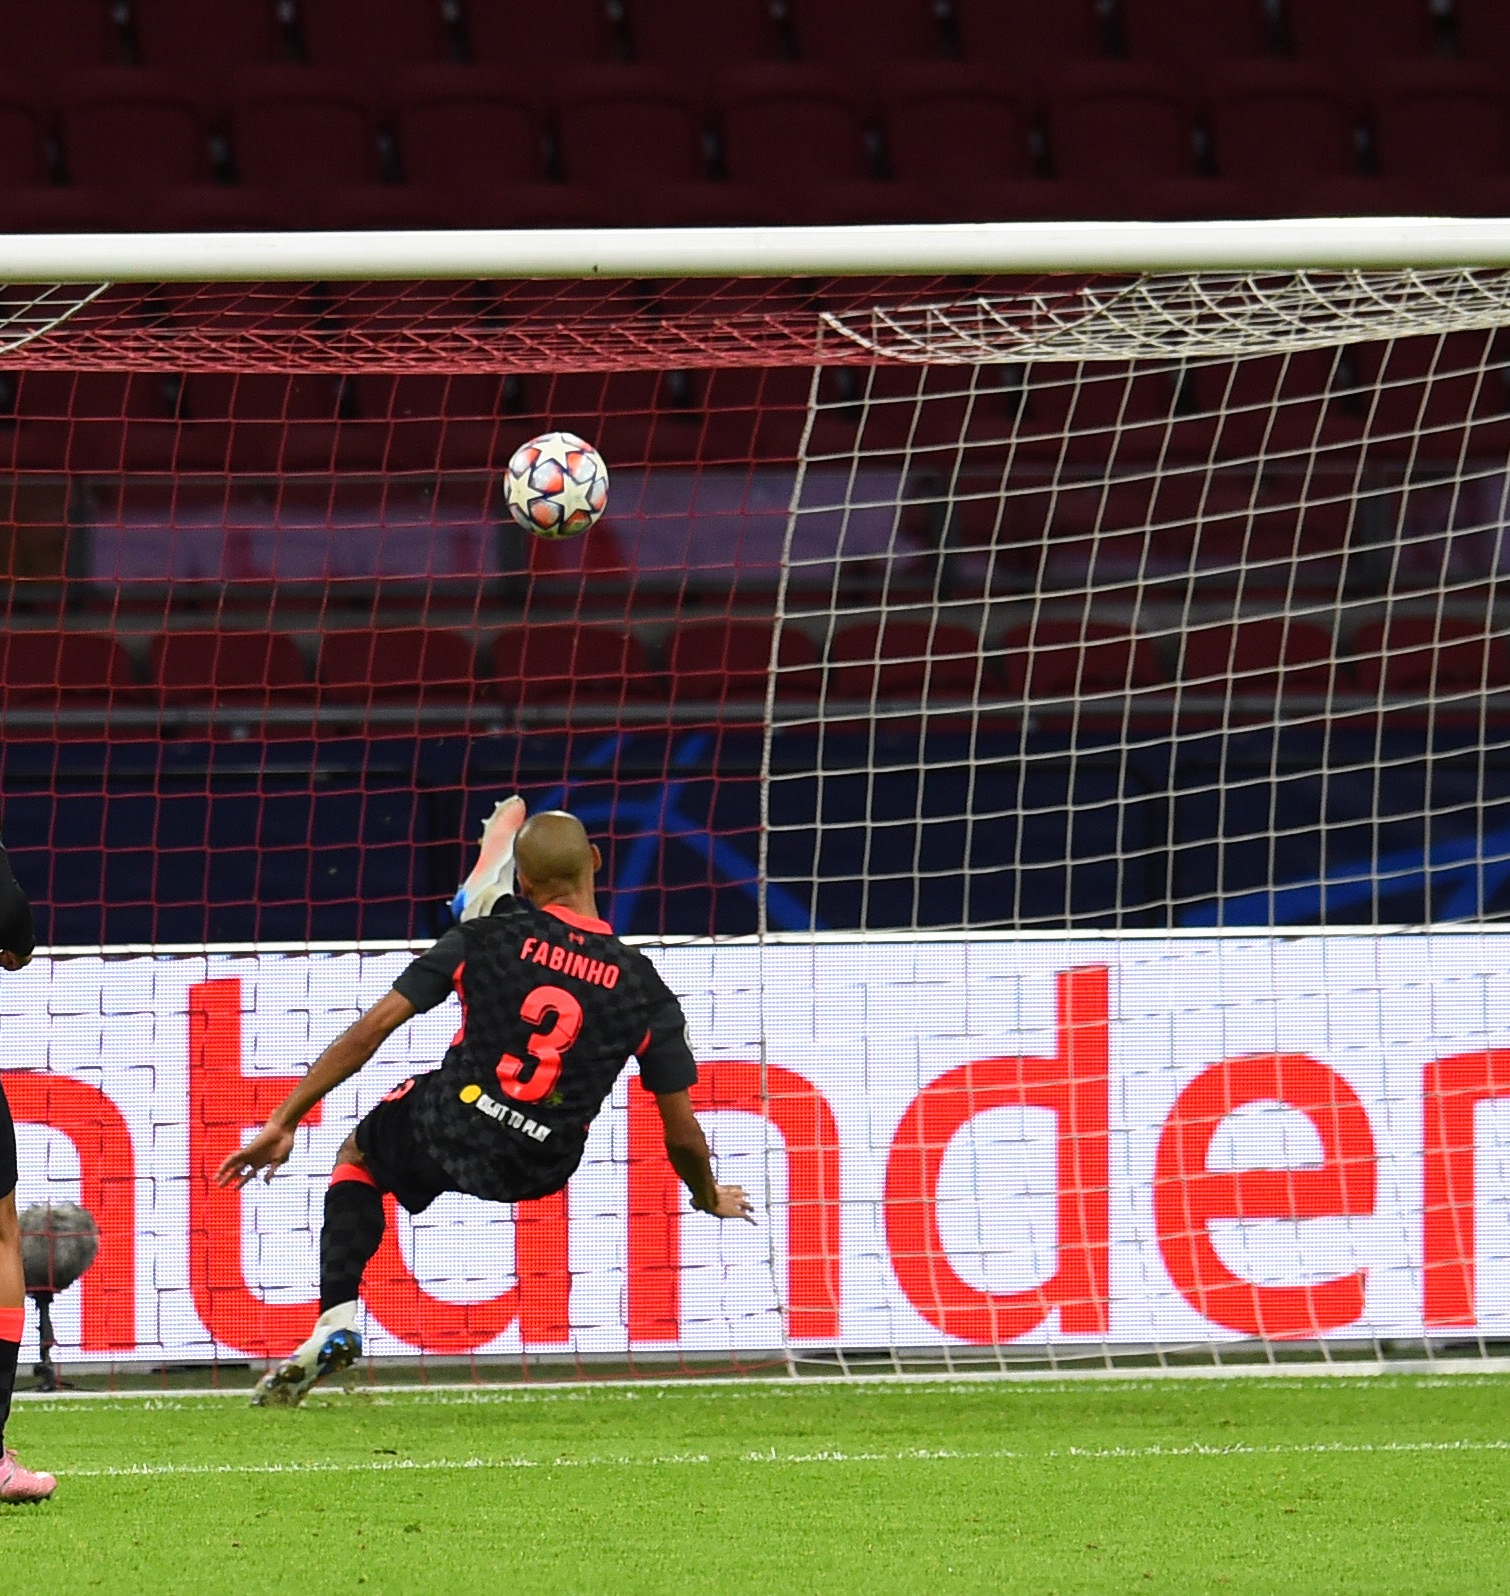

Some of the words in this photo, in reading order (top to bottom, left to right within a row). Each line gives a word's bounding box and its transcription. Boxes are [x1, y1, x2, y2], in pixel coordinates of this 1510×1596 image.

[520, 937, 621, 990] FABINHO
[495, 985, 584, 1103] 3
[507, 1109, 525, 1129] TO
